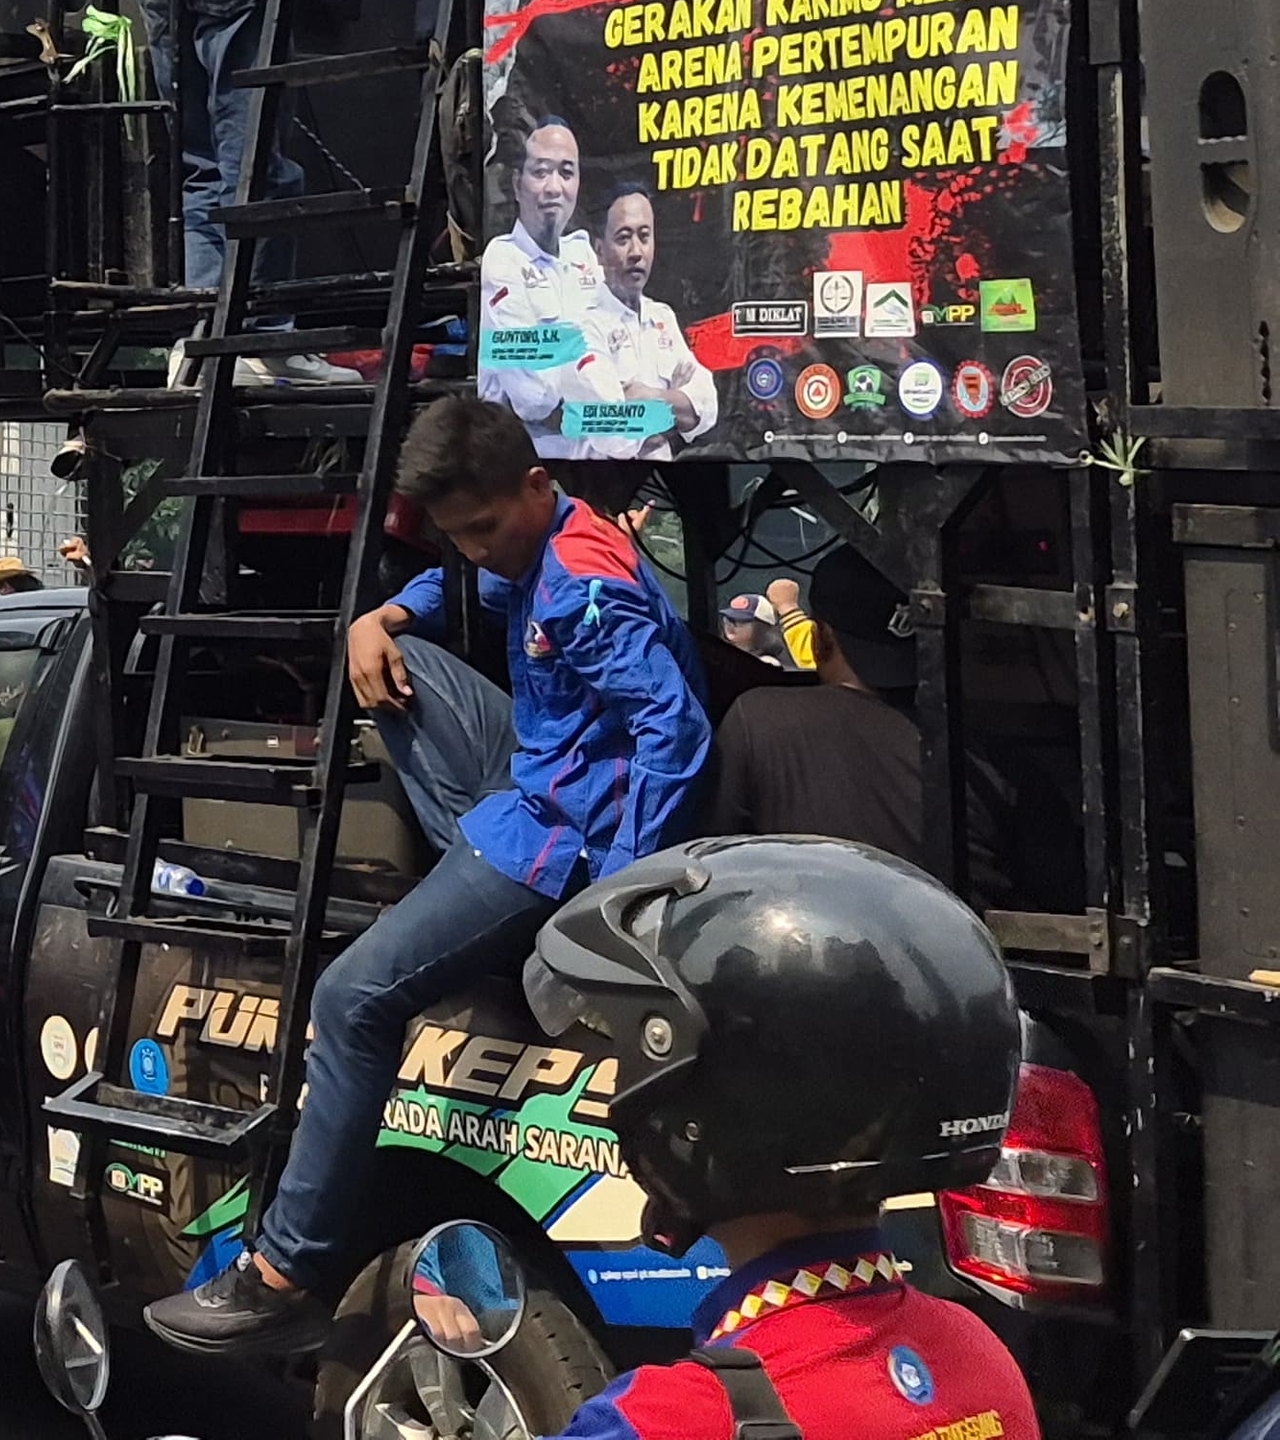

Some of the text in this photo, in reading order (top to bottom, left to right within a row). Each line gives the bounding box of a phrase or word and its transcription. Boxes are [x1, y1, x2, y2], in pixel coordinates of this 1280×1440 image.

[637, 5, 1020, 93] ARENA PERTEMPURAN
[638, 61, 1019, 143] KARENA KEMENANGAN
[652, 115, 999, 191] TIDAK DATANG SAAT
[732, 180, 904, 232] REBAHAN
[758, 306, 803, 323] DIKLAT
[397, 1026, 585, 1101] KEP
[448, 1111, 520, 1155] ARAH
